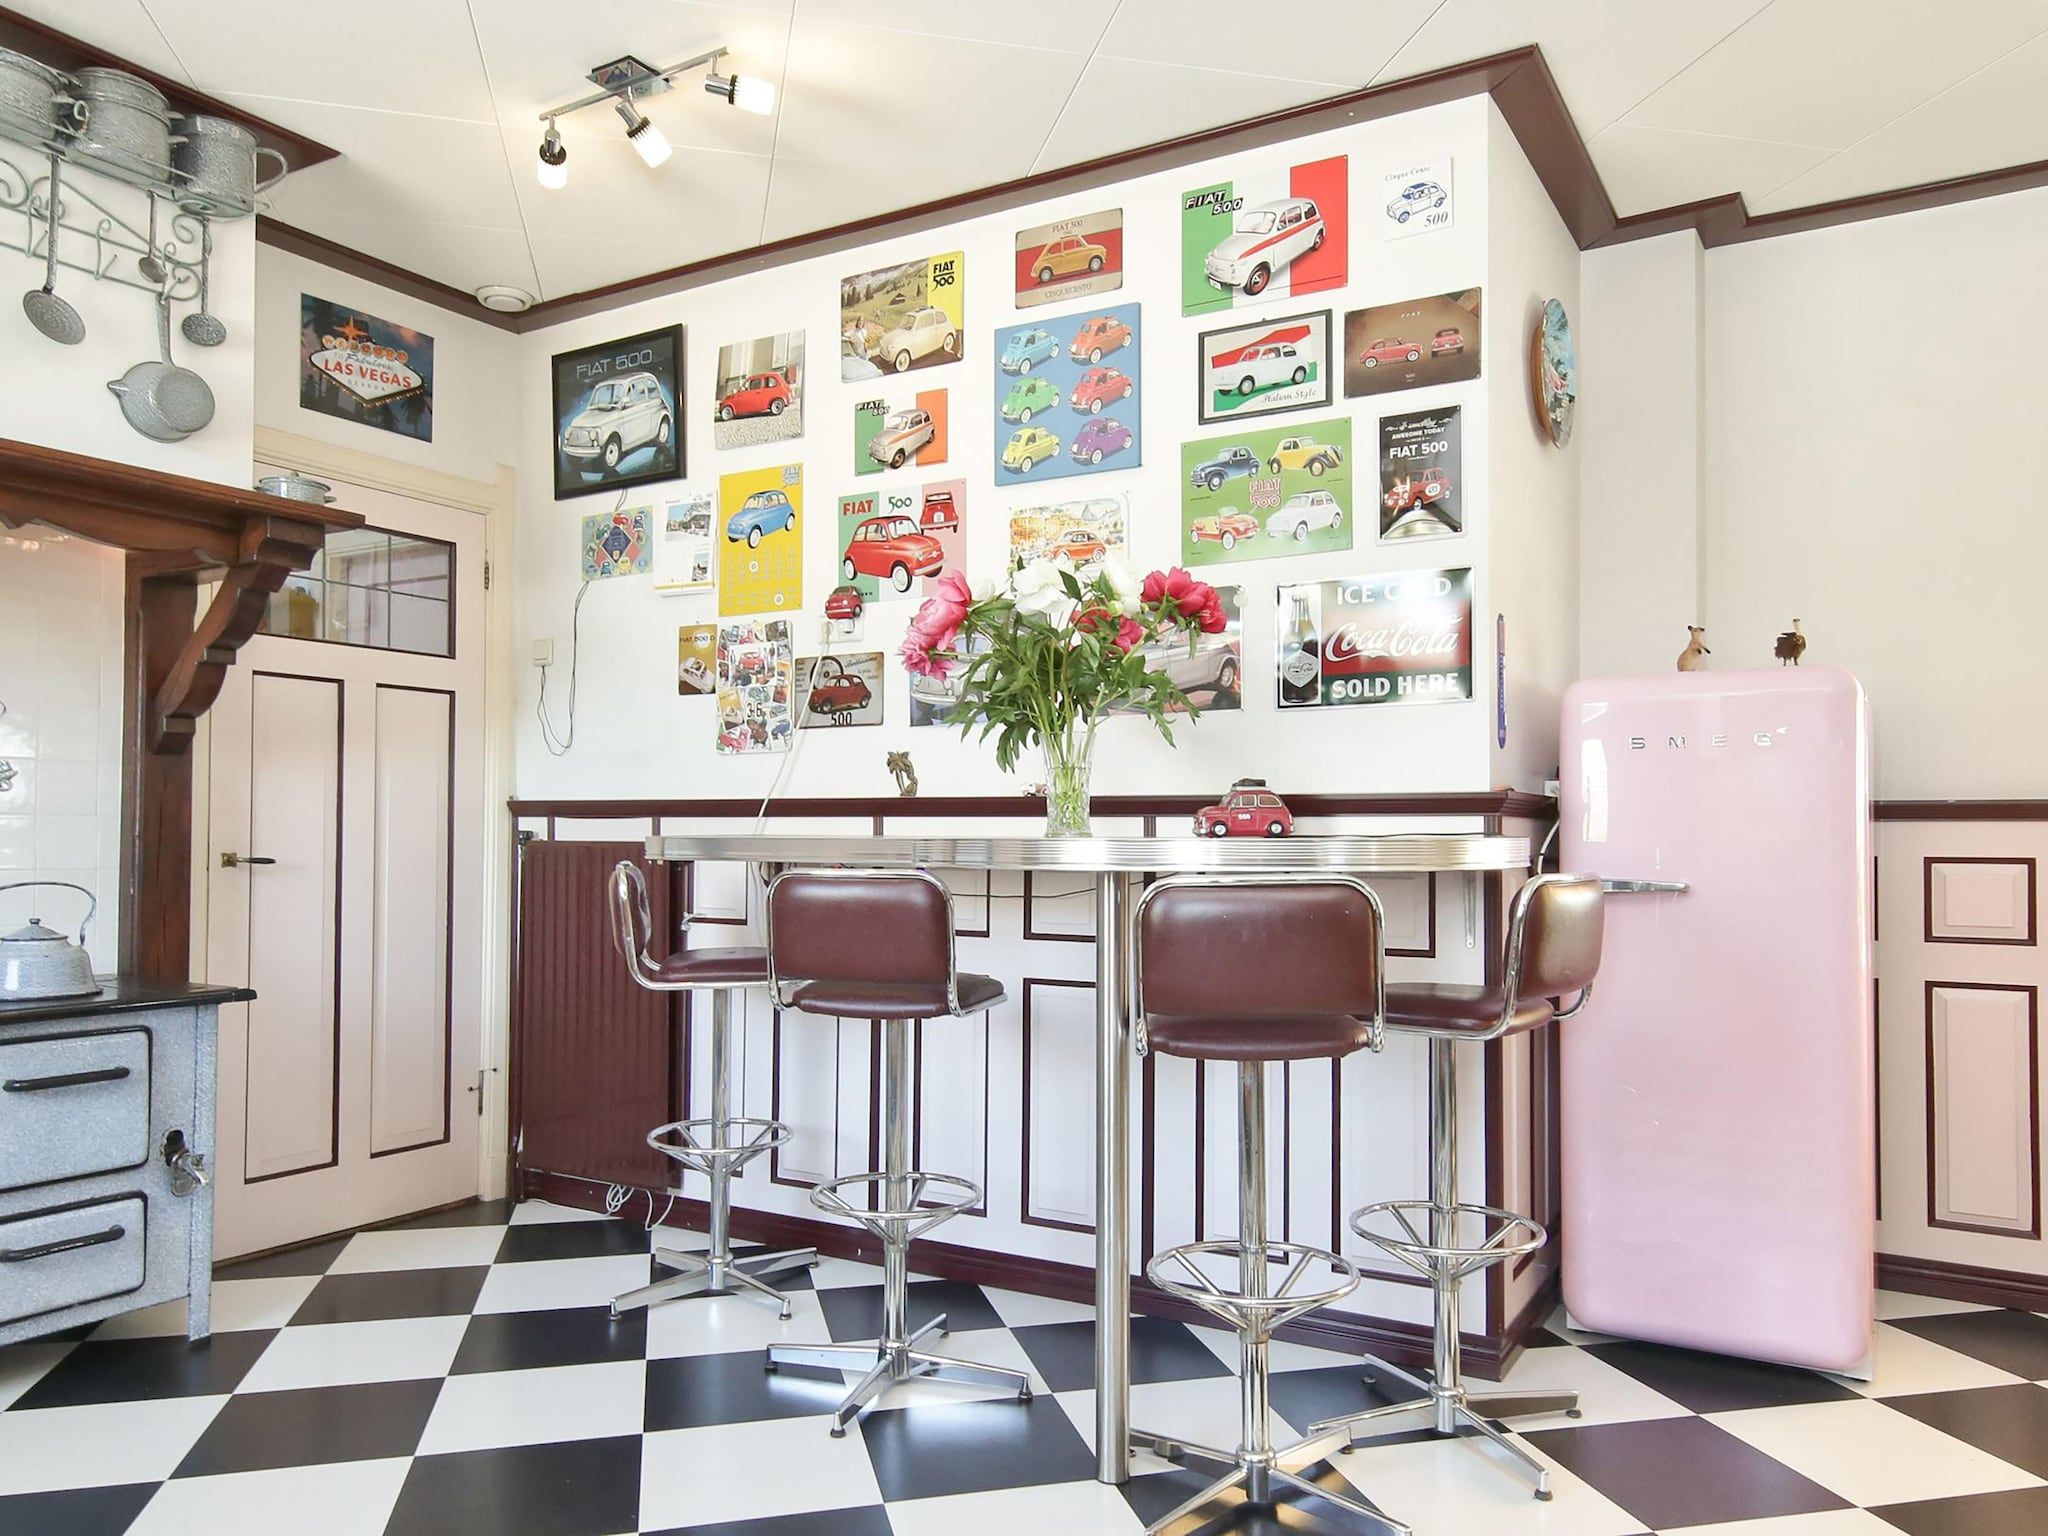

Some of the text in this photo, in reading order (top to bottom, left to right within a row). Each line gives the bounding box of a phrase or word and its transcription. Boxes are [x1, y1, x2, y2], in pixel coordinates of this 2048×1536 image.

[1185, 190, 1226, 210] FIAT
[1212, 197, 1243, 216] 500
[1052, 223, 1070, 233] FIAT
[1070, 219, 1084, 229] 500
[1424, 210, 1449, 228] 500
[933, 259, 955, 274] FIAT
[931, 275, 955, 292] 500
[1044, 283, 1093, 299] CINQUECENTO
[576, 349, 653, 379] FIAT 500
[323, 358, 412, 389] LAS VEGAS
[857, 400, 881, 411] FIAT
[872, 405, 891, 416] 500
[1391, 430, 1423, 440] AWESOME
[1423, 427, 1446, 435] TODAY
[1389, 440, 1449, 459] FIAT 500
[1249, 478, 1281, 492] FIAT
[843, 496, 913, 516] FIAT 500
[1250, 493, 1281, 509] 500
[1336, 576, 1453, 605] ICE CD
[1331, 672, 1460, 699] SOLD HERE
[831, 711, 852, 727] 500
[1629, 732, 1773, 750] SMEG
